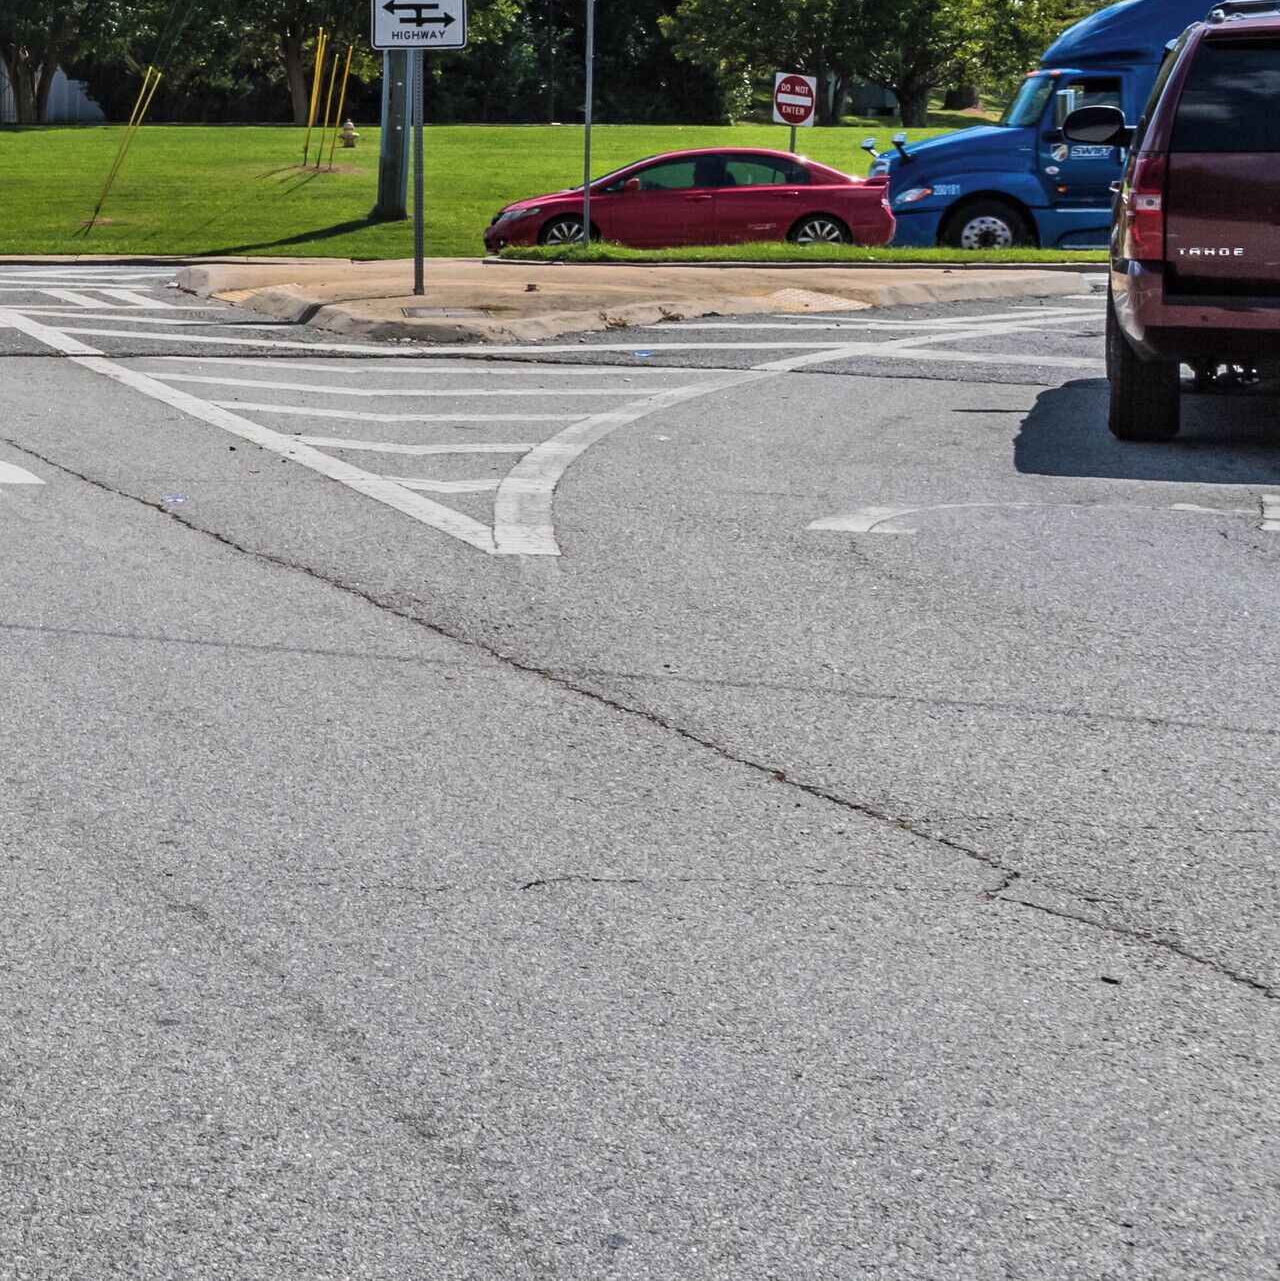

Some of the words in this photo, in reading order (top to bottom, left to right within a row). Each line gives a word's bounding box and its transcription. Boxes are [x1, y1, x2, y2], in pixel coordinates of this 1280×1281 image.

[392, 30, 446, 40] HIGHWAY
[781, 83, 791, 92] DO
[795, 85, 809, 95] NOT
[782, 105, 805, 116] ENTER
[1071, 145, 1114, 156] SWIFT
[1178, 247, 1244, 256] TAHOE
